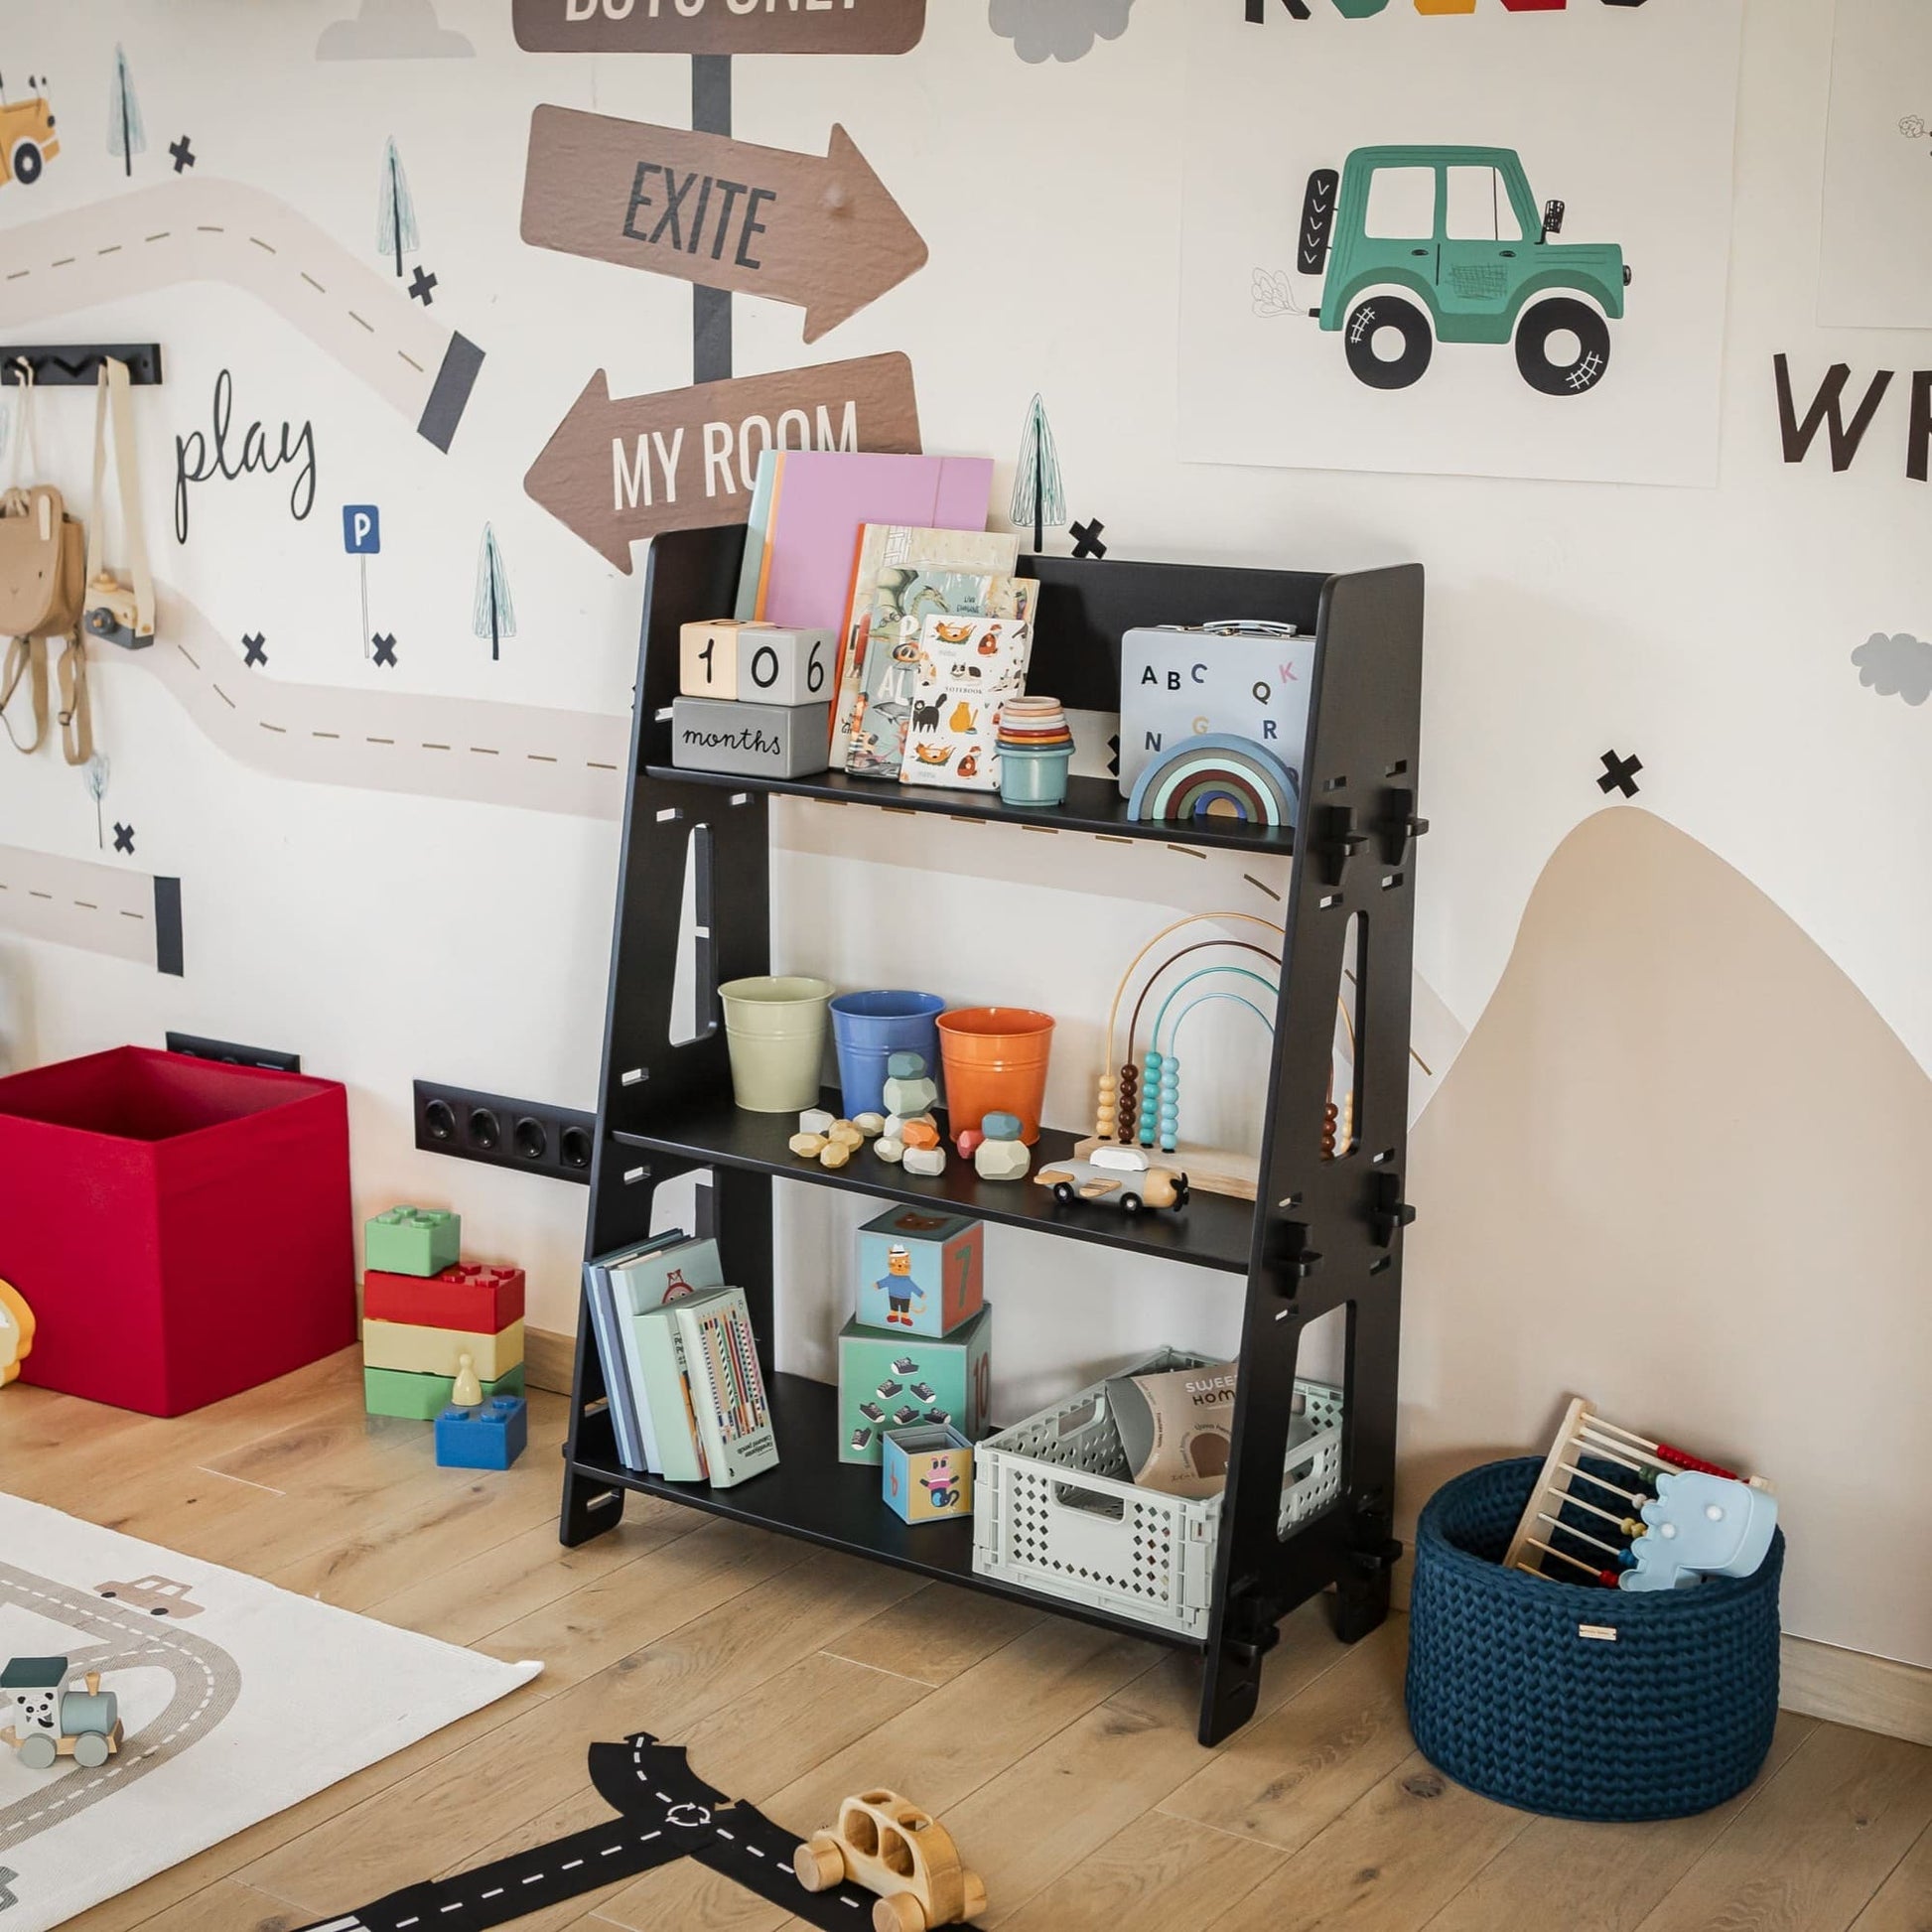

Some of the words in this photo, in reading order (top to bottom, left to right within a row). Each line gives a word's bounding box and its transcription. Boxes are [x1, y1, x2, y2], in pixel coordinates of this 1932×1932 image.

[622, 161, 776, 269] EXITE
[175, 368, 317, 545] play
[612, 427, 685, 510] MY
[353, 512, 371, 547] P
[698, 637, 715, 684] 1
[806, 640, 825, 693] 6
[1141, 665, 1159, 685] A
[1168, 671, 1181, 691] B
[1190, 663, 1208, 684] C
[1279, 661, 1299, 684] K
[1252, 681, 1272, 705] Q
[1191, 716, 1209, 735] G
[1263, 720, 1278, 740] R
[682, 728, 781, 756] months
[1145, 731, 1163, 753] N
[954, 1243, 972, 1310] 7
[973, 1351, 989, 1432] 10
[1184, 1374, 1238, 1393] SWEE
